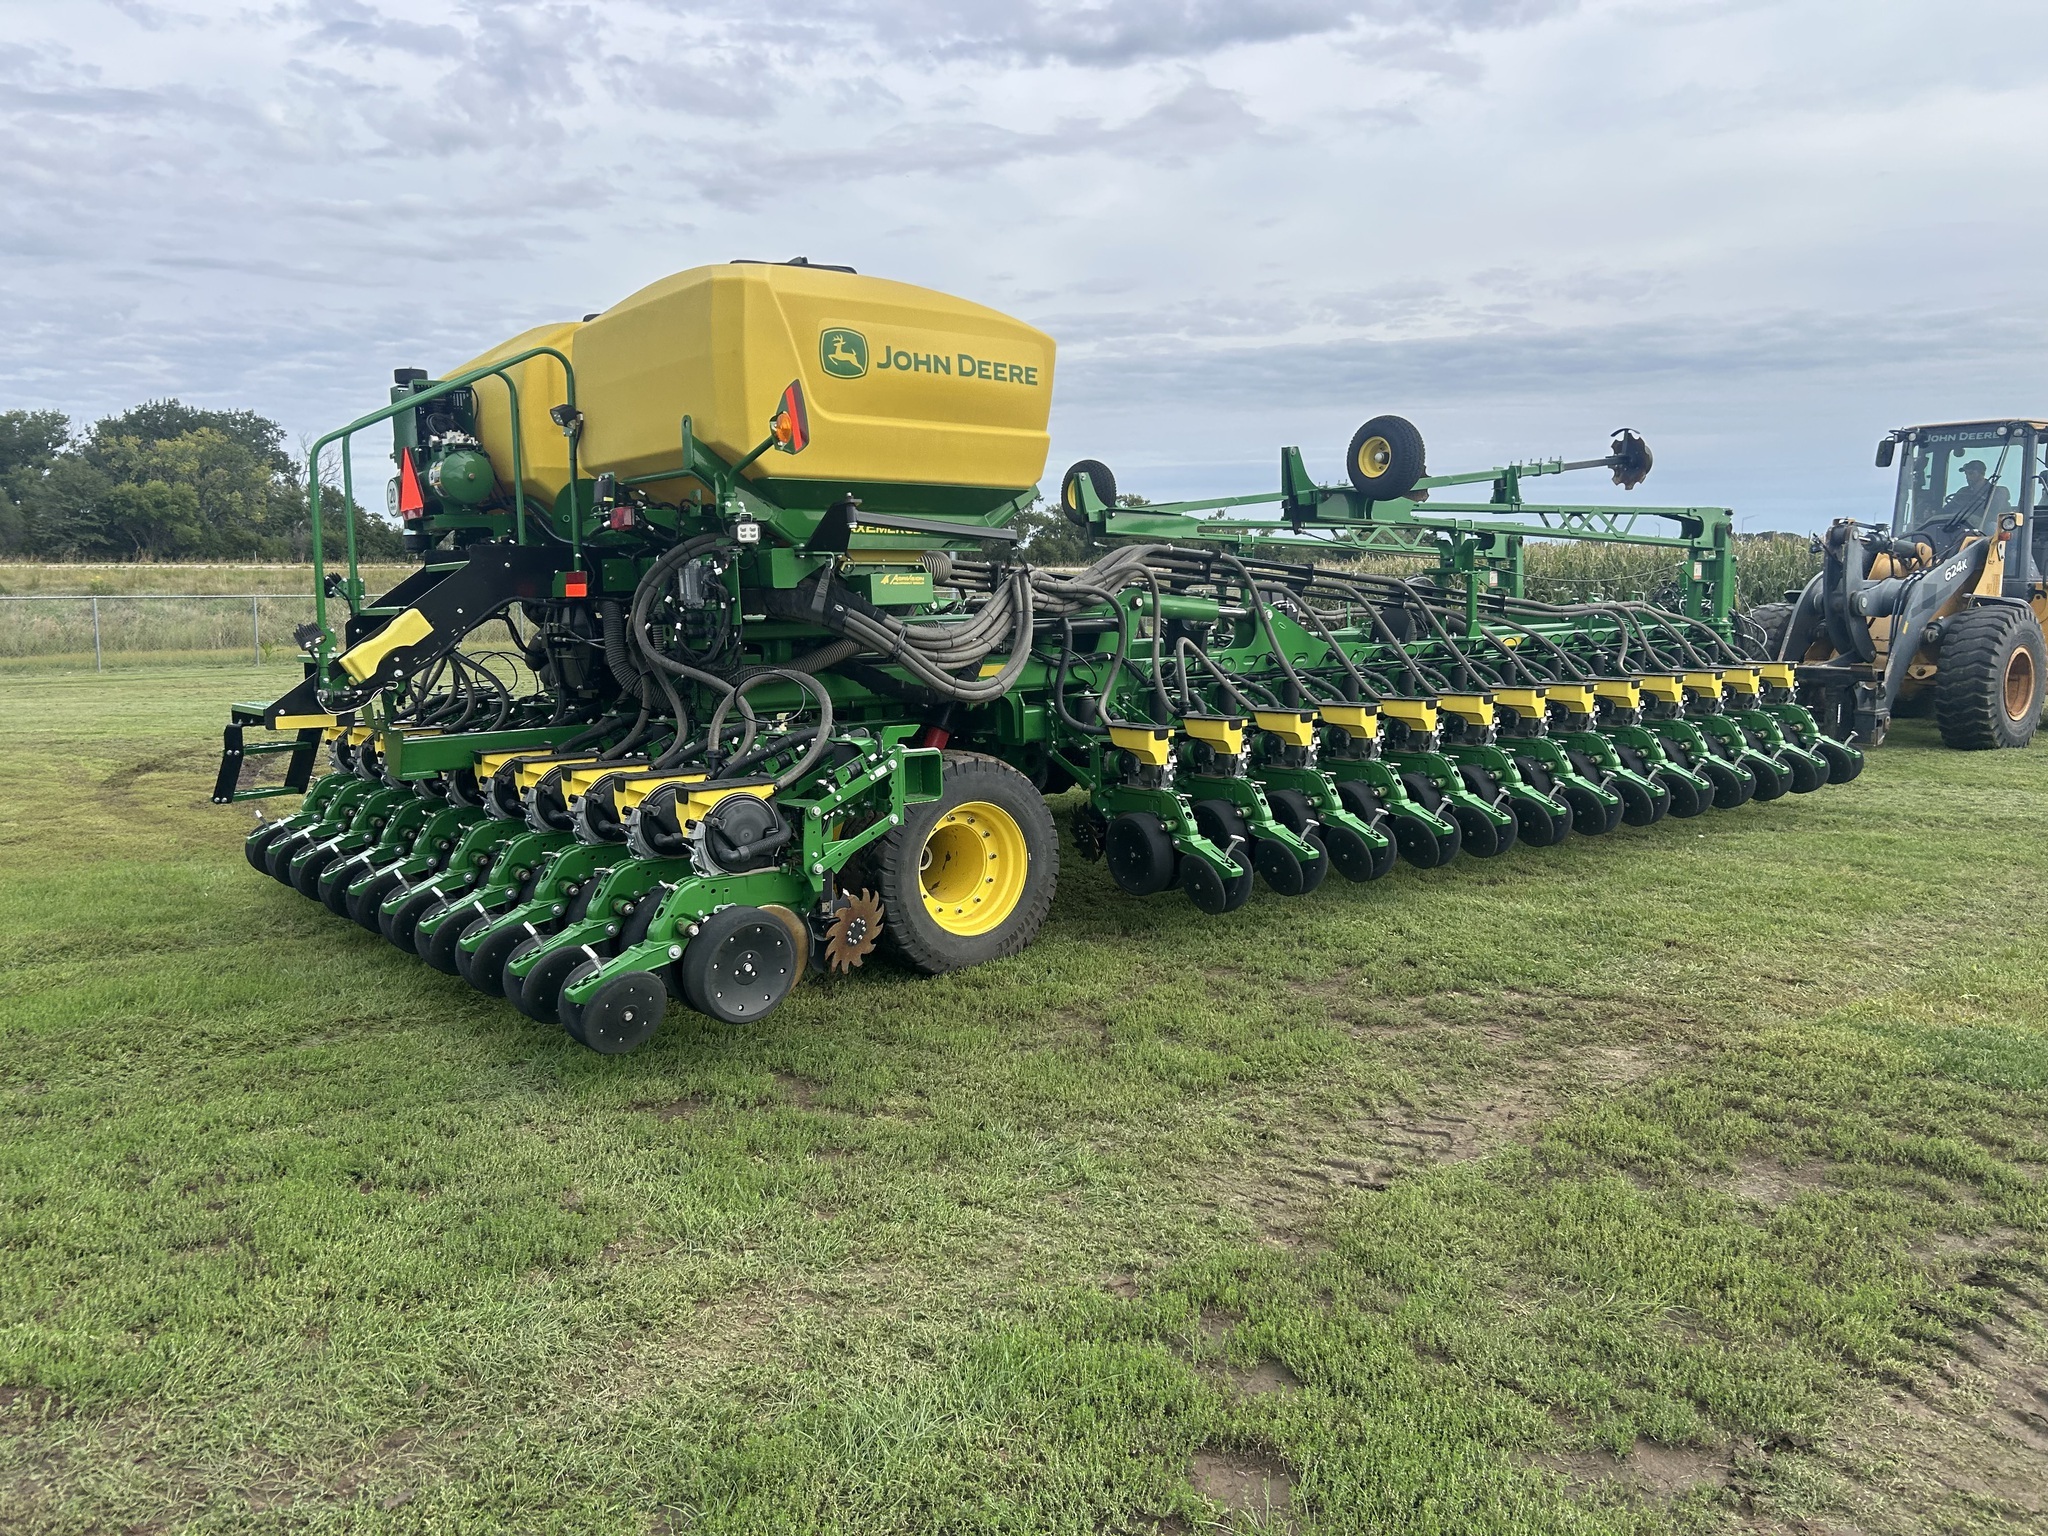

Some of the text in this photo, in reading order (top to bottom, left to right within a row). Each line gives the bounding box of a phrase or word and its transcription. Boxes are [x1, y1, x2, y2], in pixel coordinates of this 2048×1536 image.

[877, 345, 1038, 386] JOHN DEERE
[1924, 434, 1957, 443] JOHN
[1944, 558, 1968, 581] 624K
